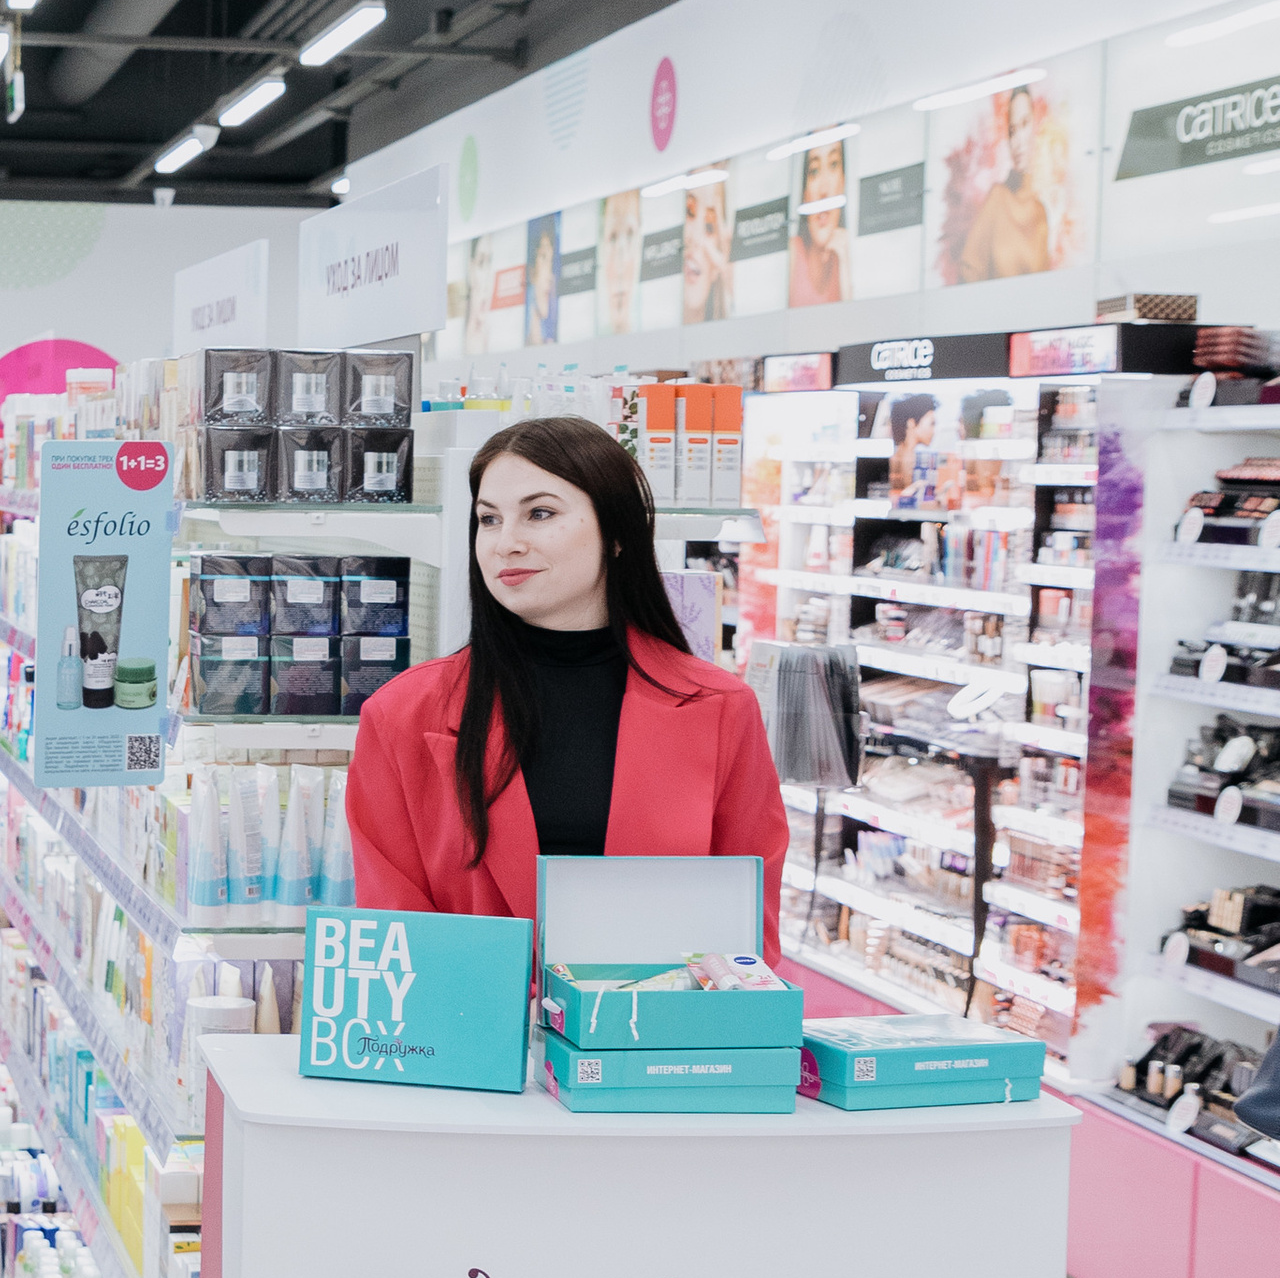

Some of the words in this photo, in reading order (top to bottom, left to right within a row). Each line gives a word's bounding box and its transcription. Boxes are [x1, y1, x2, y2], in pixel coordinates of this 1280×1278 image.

[350, 255, 362, 289] ЗА
[363, 242, 400, 287] ЛИЦОМ
[72, 462, 113, 470] БЕСПЛАТНО!
[119, 455, 166, 471] 1+1=3
[314, 917, 413, 972] BEA
[312, 967, 417, 1022] UTY
[357, 1034, 436, 1059] Подружка
[646, 1064, 733, 1075] ИНТЕРНЕТ-МАГАЗИН
[914, 1058, 989, 1071] ИНТЕРНЕТ-МАГАЗИН
